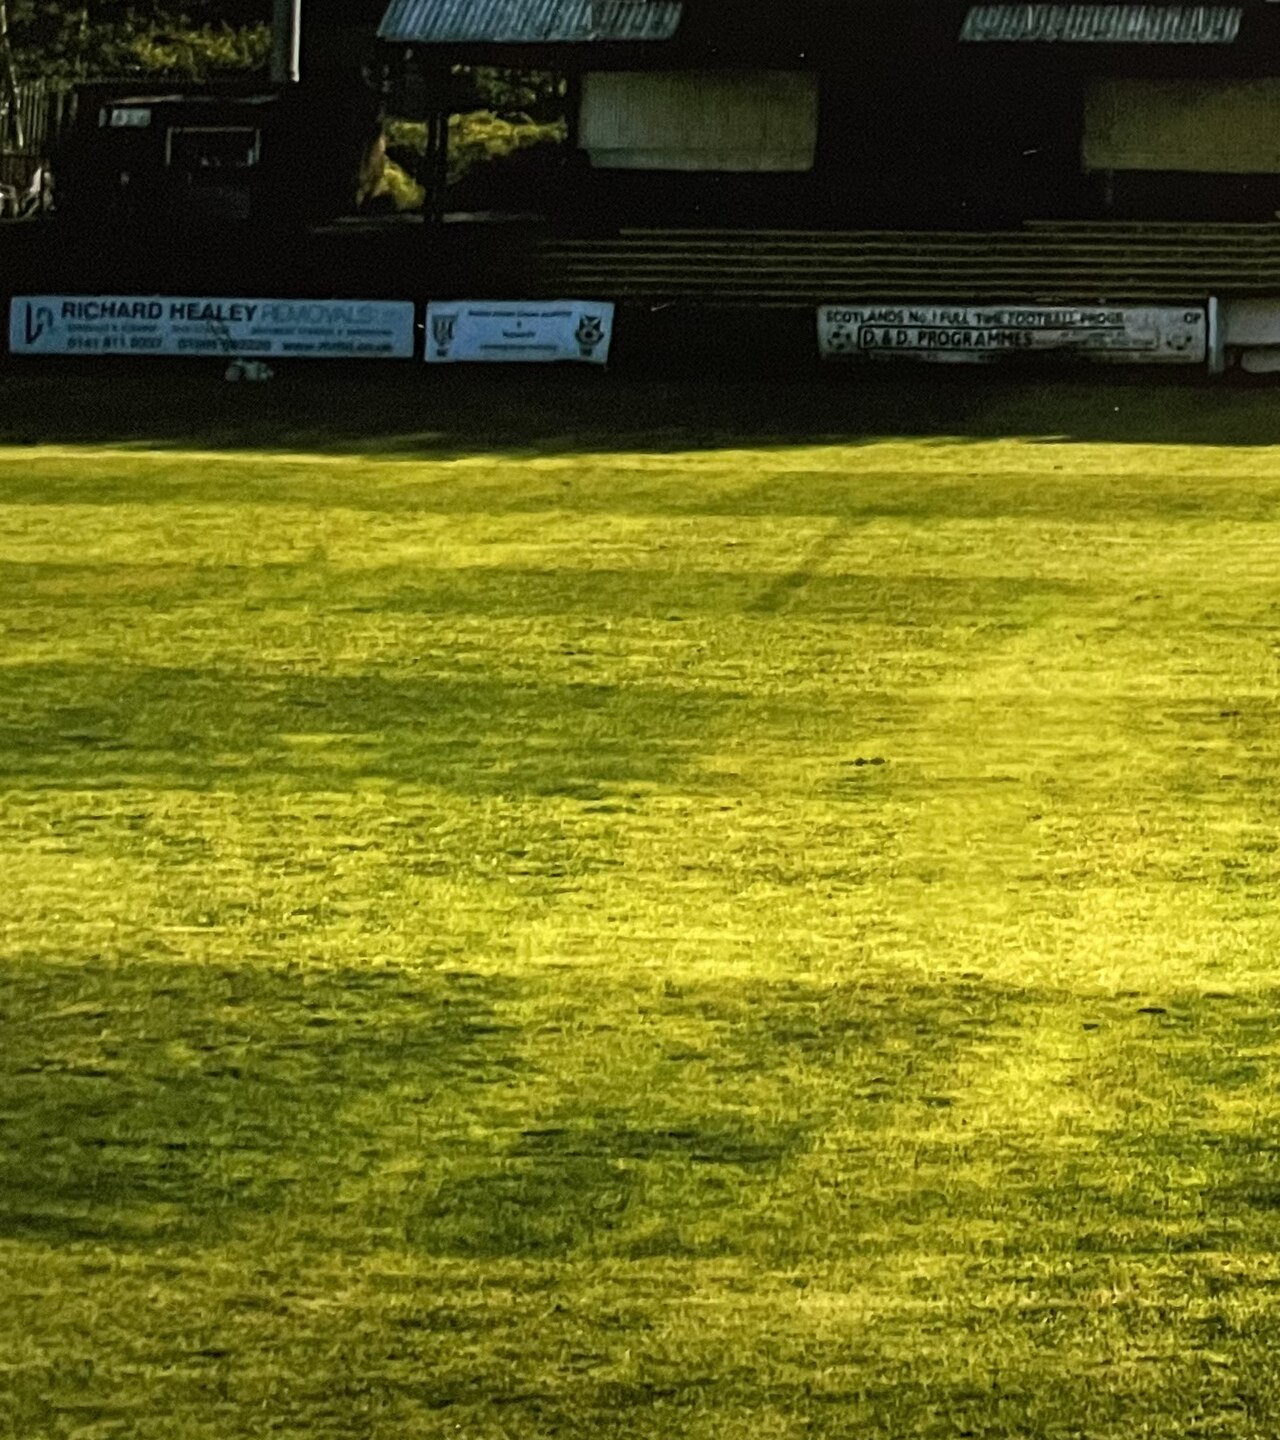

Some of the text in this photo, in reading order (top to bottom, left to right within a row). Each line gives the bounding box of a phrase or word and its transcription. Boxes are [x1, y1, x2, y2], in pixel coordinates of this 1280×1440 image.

[61, 302, 162, 320] RICHARD
[169, 303, 258, 322] HEALEY
[918, 330, 1033, 348] PROGRAMMES
